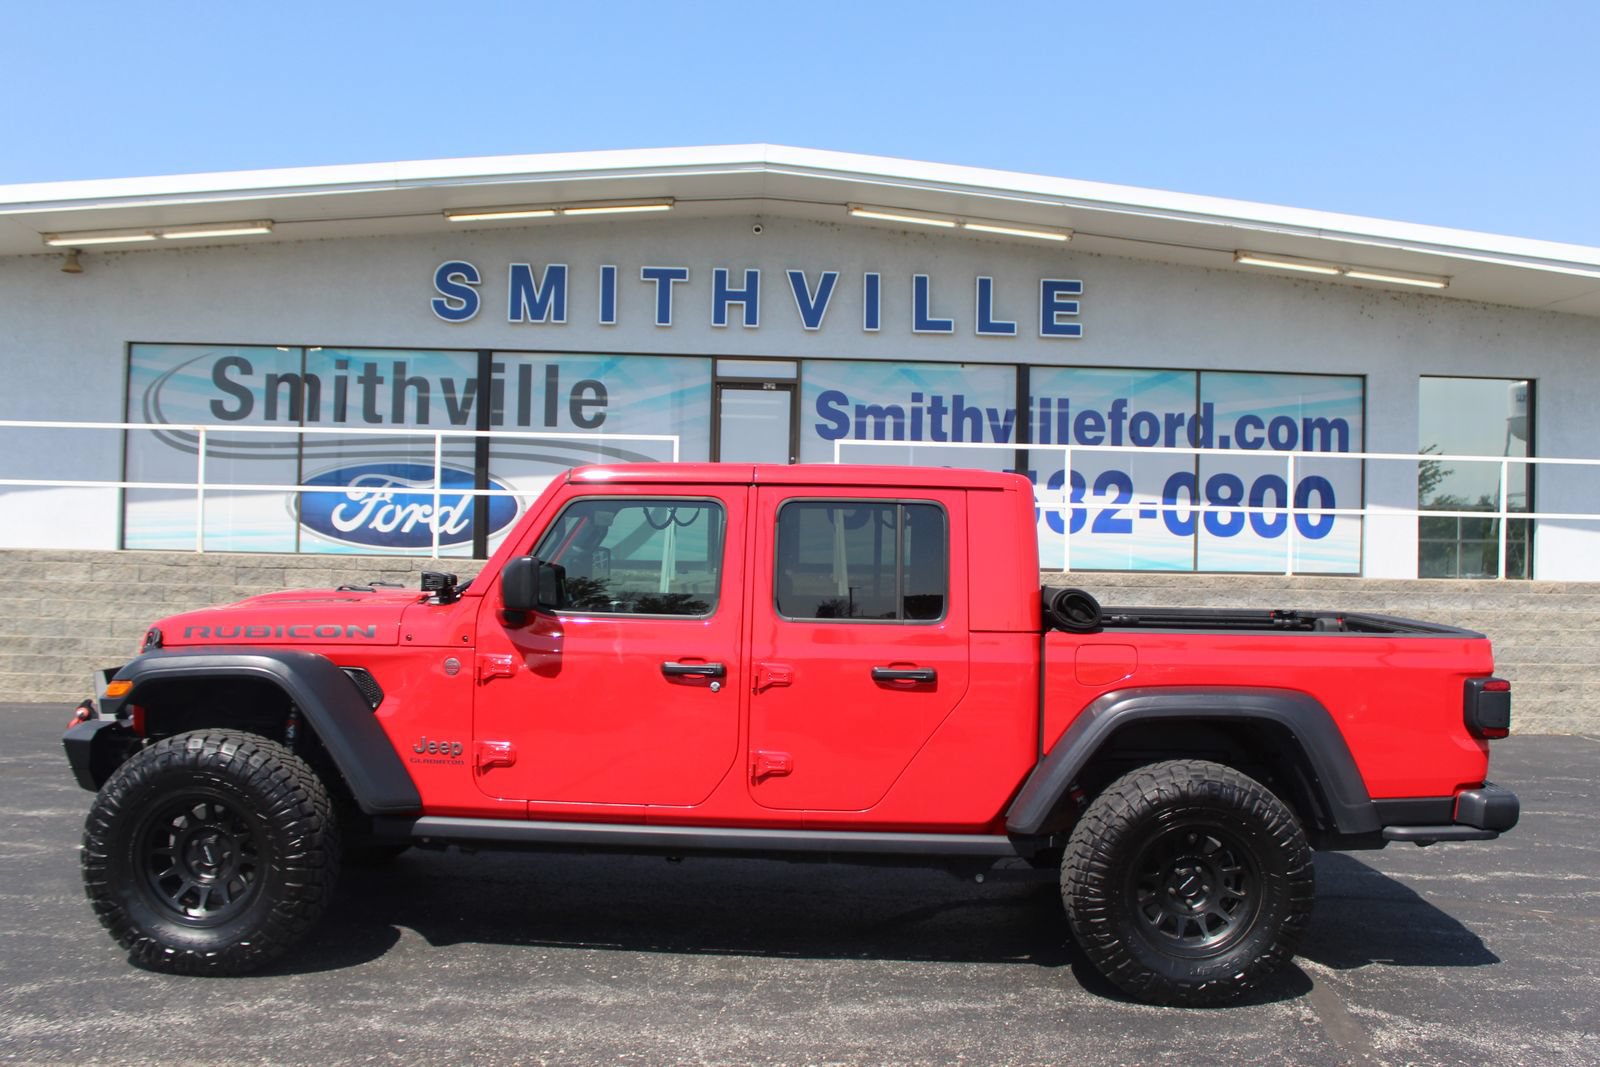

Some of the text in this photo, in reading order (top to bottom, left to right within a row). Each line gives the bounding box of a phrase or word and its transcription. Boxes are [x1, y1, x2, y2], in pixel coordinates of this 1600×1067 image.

[431, 260, 1083, 339] SMITHVILLE
[209, 356, 608, 428] Smithville
[331, 474, 471, 535] Ford
[183, 624, 377, 639] RUBICON
[412, 735, 463, 758] Jeep
